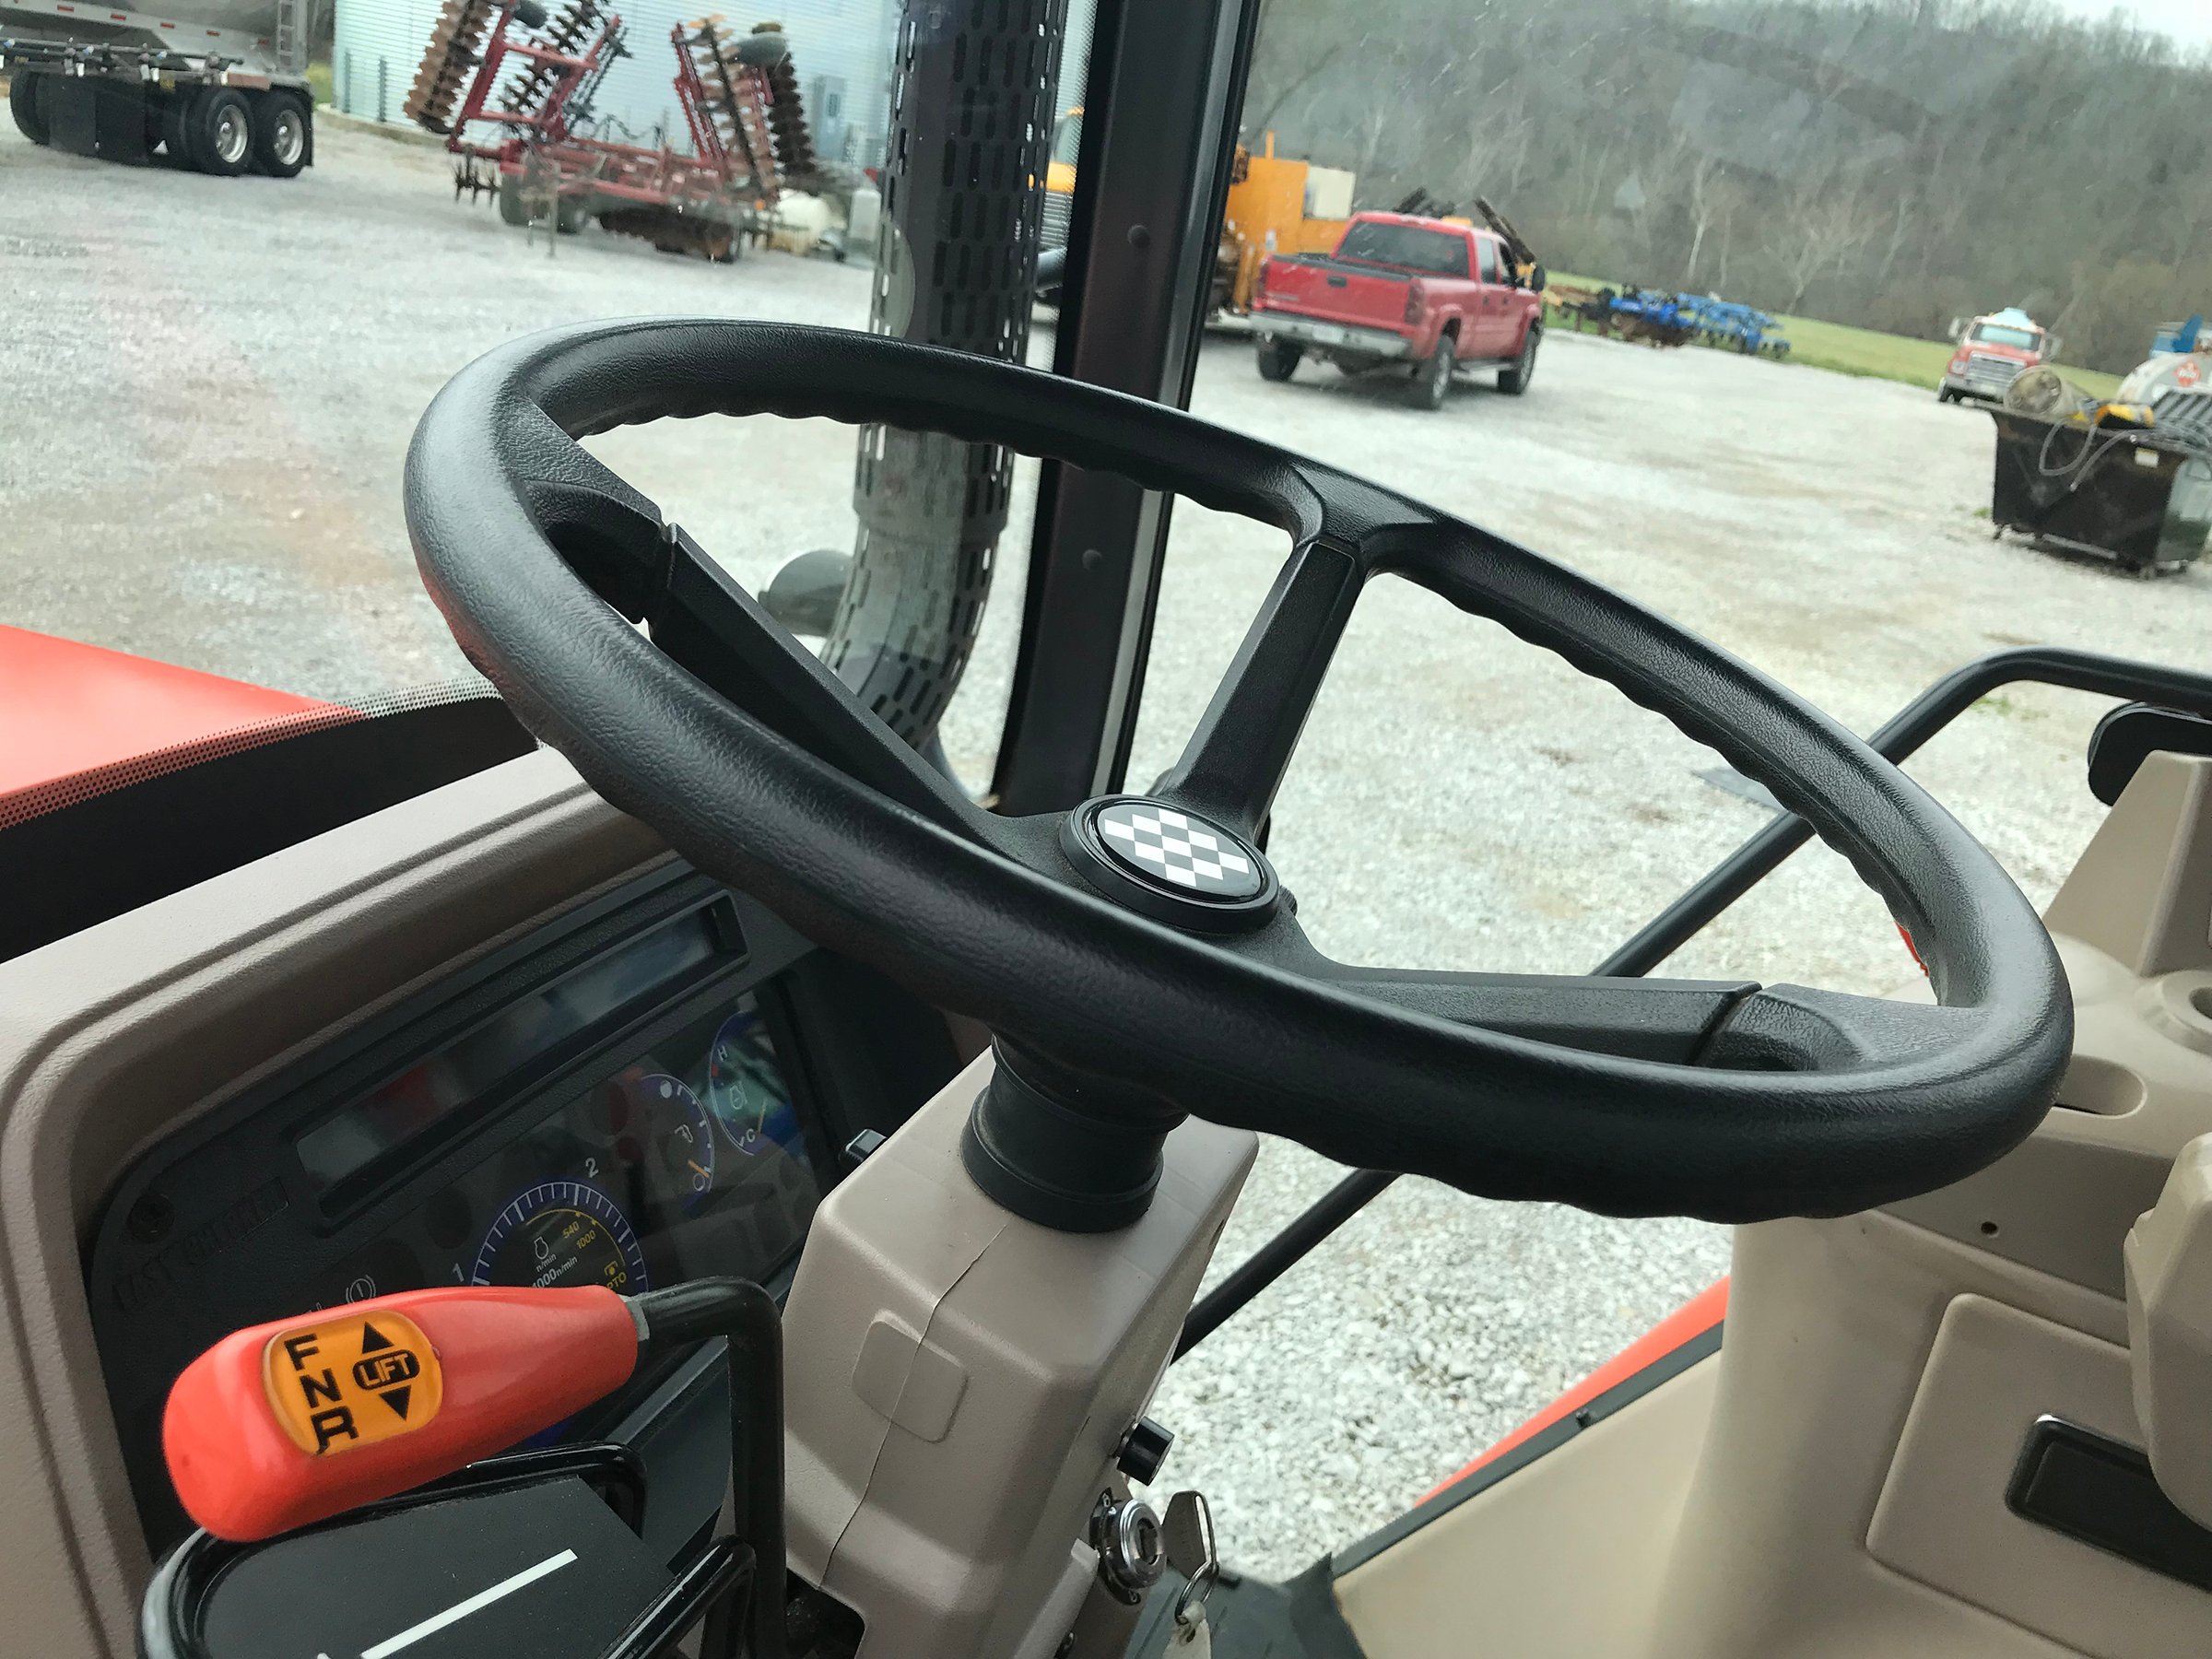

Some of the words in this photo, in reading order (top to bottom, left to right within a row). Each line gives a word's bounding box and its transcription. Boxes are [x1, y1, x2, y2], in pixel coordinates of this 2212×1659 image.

[585, 1158, 599, 1178] 2
[562, 1221, 581, 1239] 540
[576, 1230, 596, 1249] 1000
[453, 1263, 465, 1282] 1
[535, 1253, 557, 1273] n/min
[606, 1271, 628, 1289] PTO
[284, 1333, 321, 1371] F
[359, 1353, 411, 1386] LIFT
[299, 1368, 343, 1408] N
[310, 1405, 359, 1456] R
